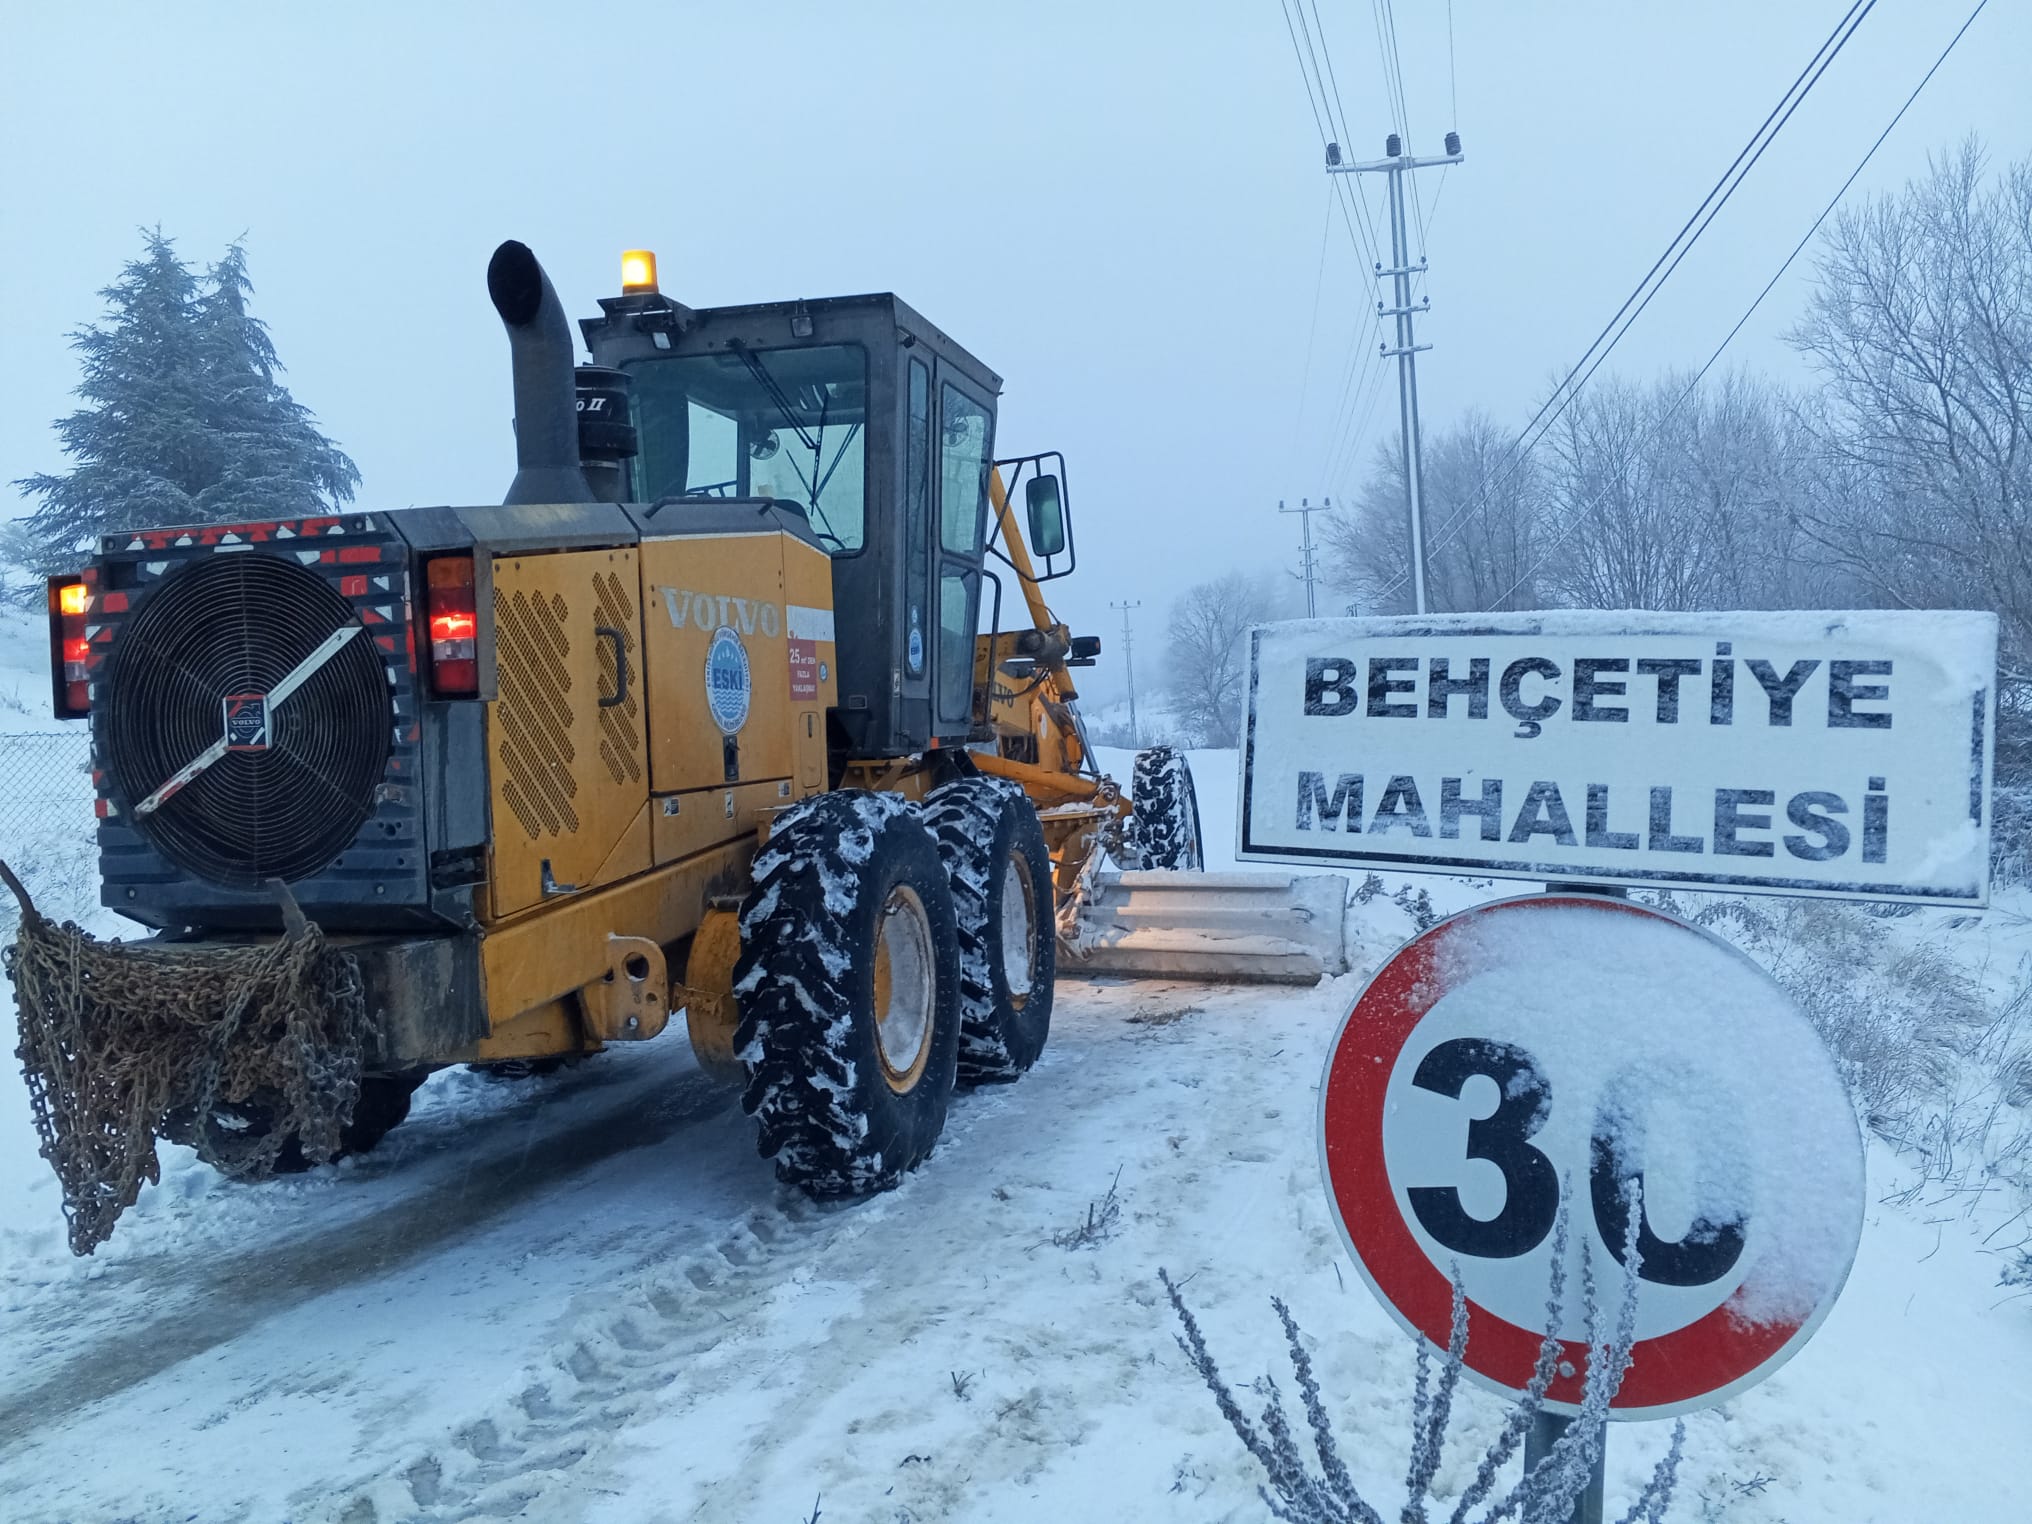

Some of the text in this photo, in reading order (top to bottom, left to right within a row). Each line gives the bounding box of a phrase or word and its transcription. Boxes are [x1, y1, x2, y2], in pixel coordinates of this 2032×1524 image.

[658, 586, 779, 637] VOLVO
[713, 667, 744, 690] ESKİ
[789, 648, 800, 664] 25
[1303, 642, 1893, 738] BEHÇETİYE
[1295, 771, 1889, 864] MAHALLESİ
[1407, 1037, 1750, 1287] 30
